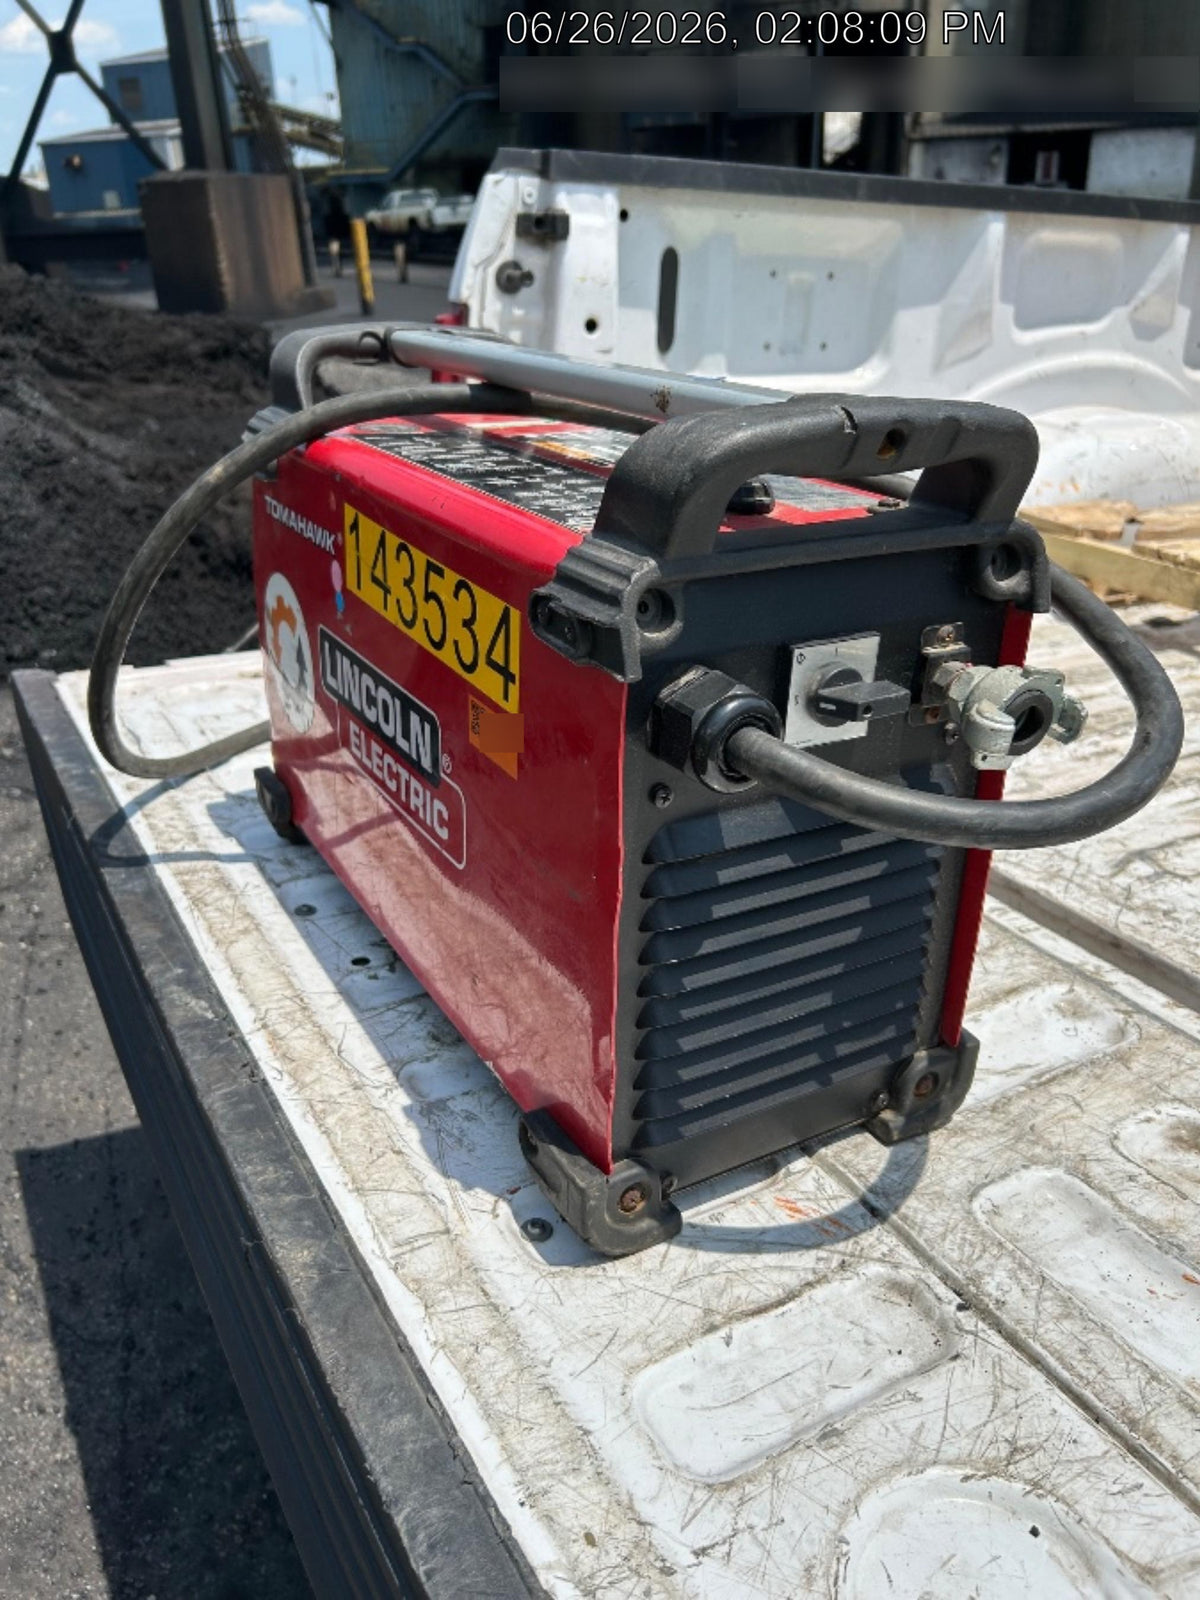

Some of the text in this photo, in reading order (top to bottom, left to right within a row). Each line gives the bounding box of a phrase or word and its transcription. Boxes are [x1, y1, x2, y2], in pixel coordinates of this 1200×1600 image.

[264, 495, 336, 555] TOMAHAWK
[349, 511, 516, 703] 143534
[324, 641, 432, 774] LINCOLN
[350, 719, 449, 840] ELECTRIC
